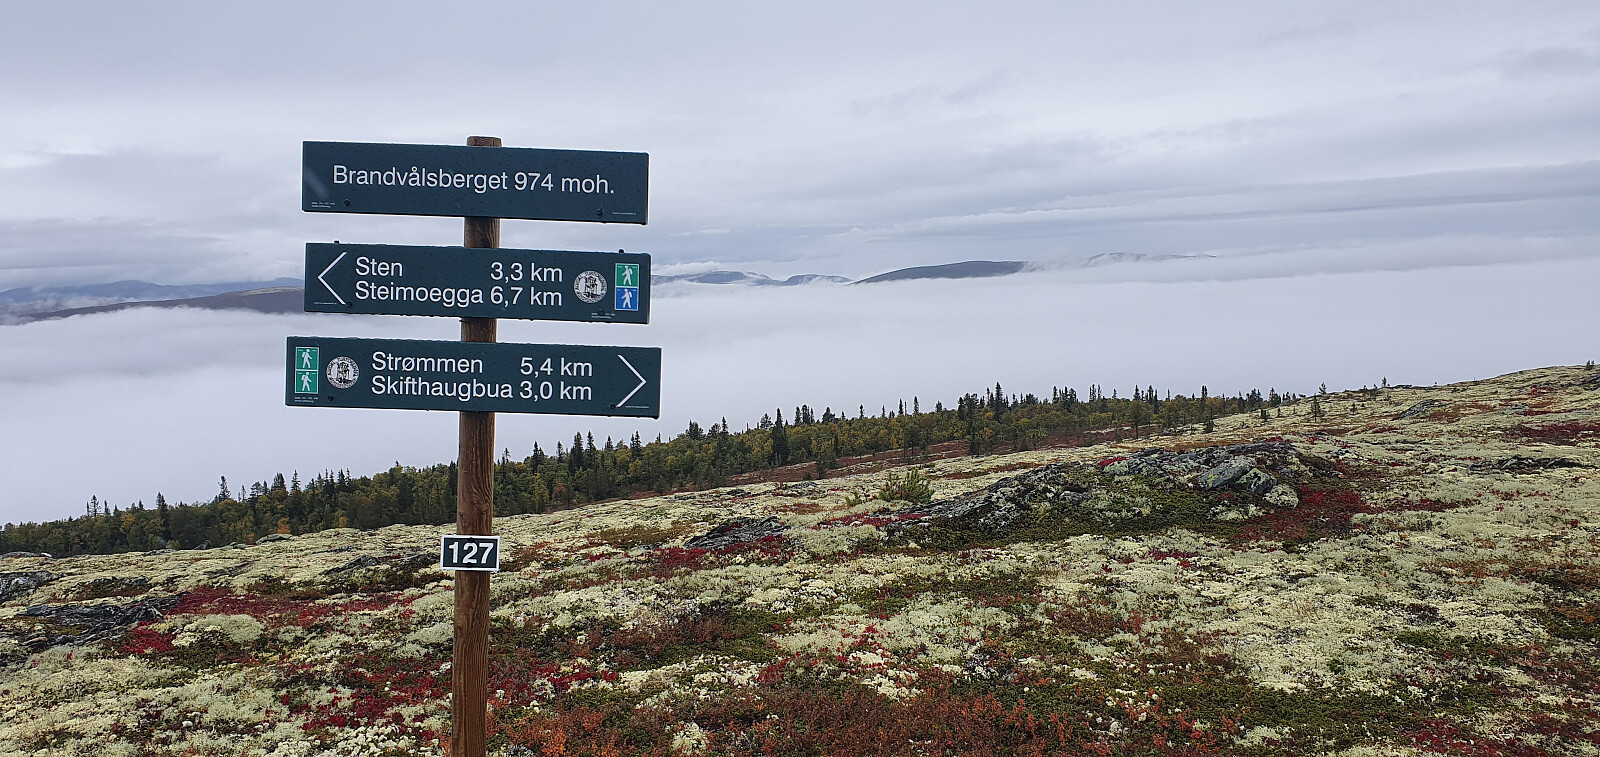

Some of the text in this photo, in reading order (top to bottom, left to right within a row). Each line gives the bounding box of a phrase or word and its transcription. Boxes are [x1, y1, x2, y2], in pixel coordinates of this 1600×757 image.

[333, 164, 615, 194] Brandvålsberget 974 moh.
[355, 256, 563, 283] Sten 3,3 km
[355, 280, 484, 308] Steimoegga
[490, 285, 524, 307] 6,7
[530, 286, 562, 307] km
[371, 351, 483, 374] Strømmen
[520, 356, 554, 378] 5,4
[560, 357, 593, 377] km
[371, 375, 592, 402] Skifthaugbua 3,0 km
[448, 541, 494, 564] 127
